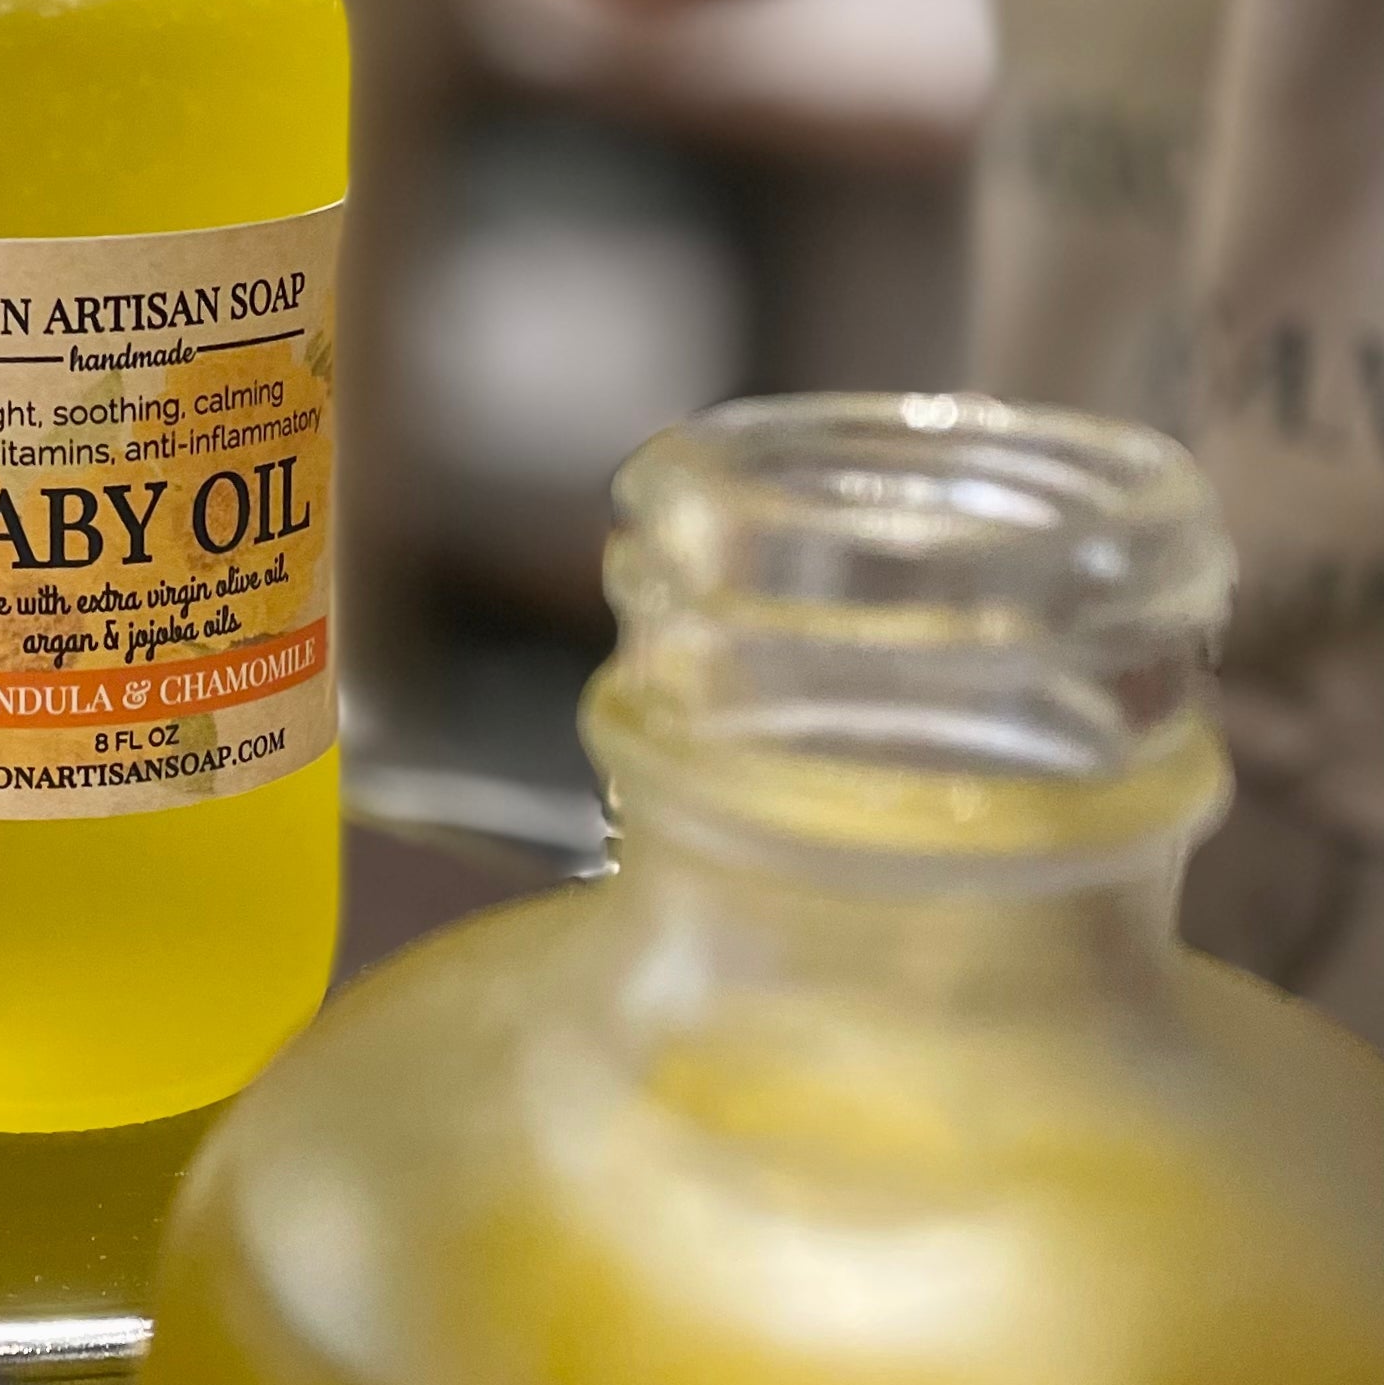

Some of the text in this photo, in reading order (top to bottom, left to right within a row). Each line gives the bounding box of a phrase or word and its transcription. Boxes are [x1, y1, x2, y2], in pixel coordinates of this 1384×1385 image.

[43, 286, 220, 334] ARTISAN
[230, 271, 305, 322] SOAP
[69, 338, 197, 373] handmade
[53, 396, 186, 426] soothing,
[194, 378, 284, 416] calming
[125, 405, 322, 462] anti-inflammatory
[192, 455, 310, 555] OIL
[17, 585, 71, 617] with
[77, 582, 142, 614] extra
[147, 575, 211, 619] virgin
[216, 567, 261, 599] olive
[263, 553, 289, 587] oil,
[23, 607, 242, 670] argan & jojoba oils
[121, 679, 150, 709] &
[160, 638, 315, 707] CHAMOMILE
[95, 724, 180, 753] 8 FL OZ
